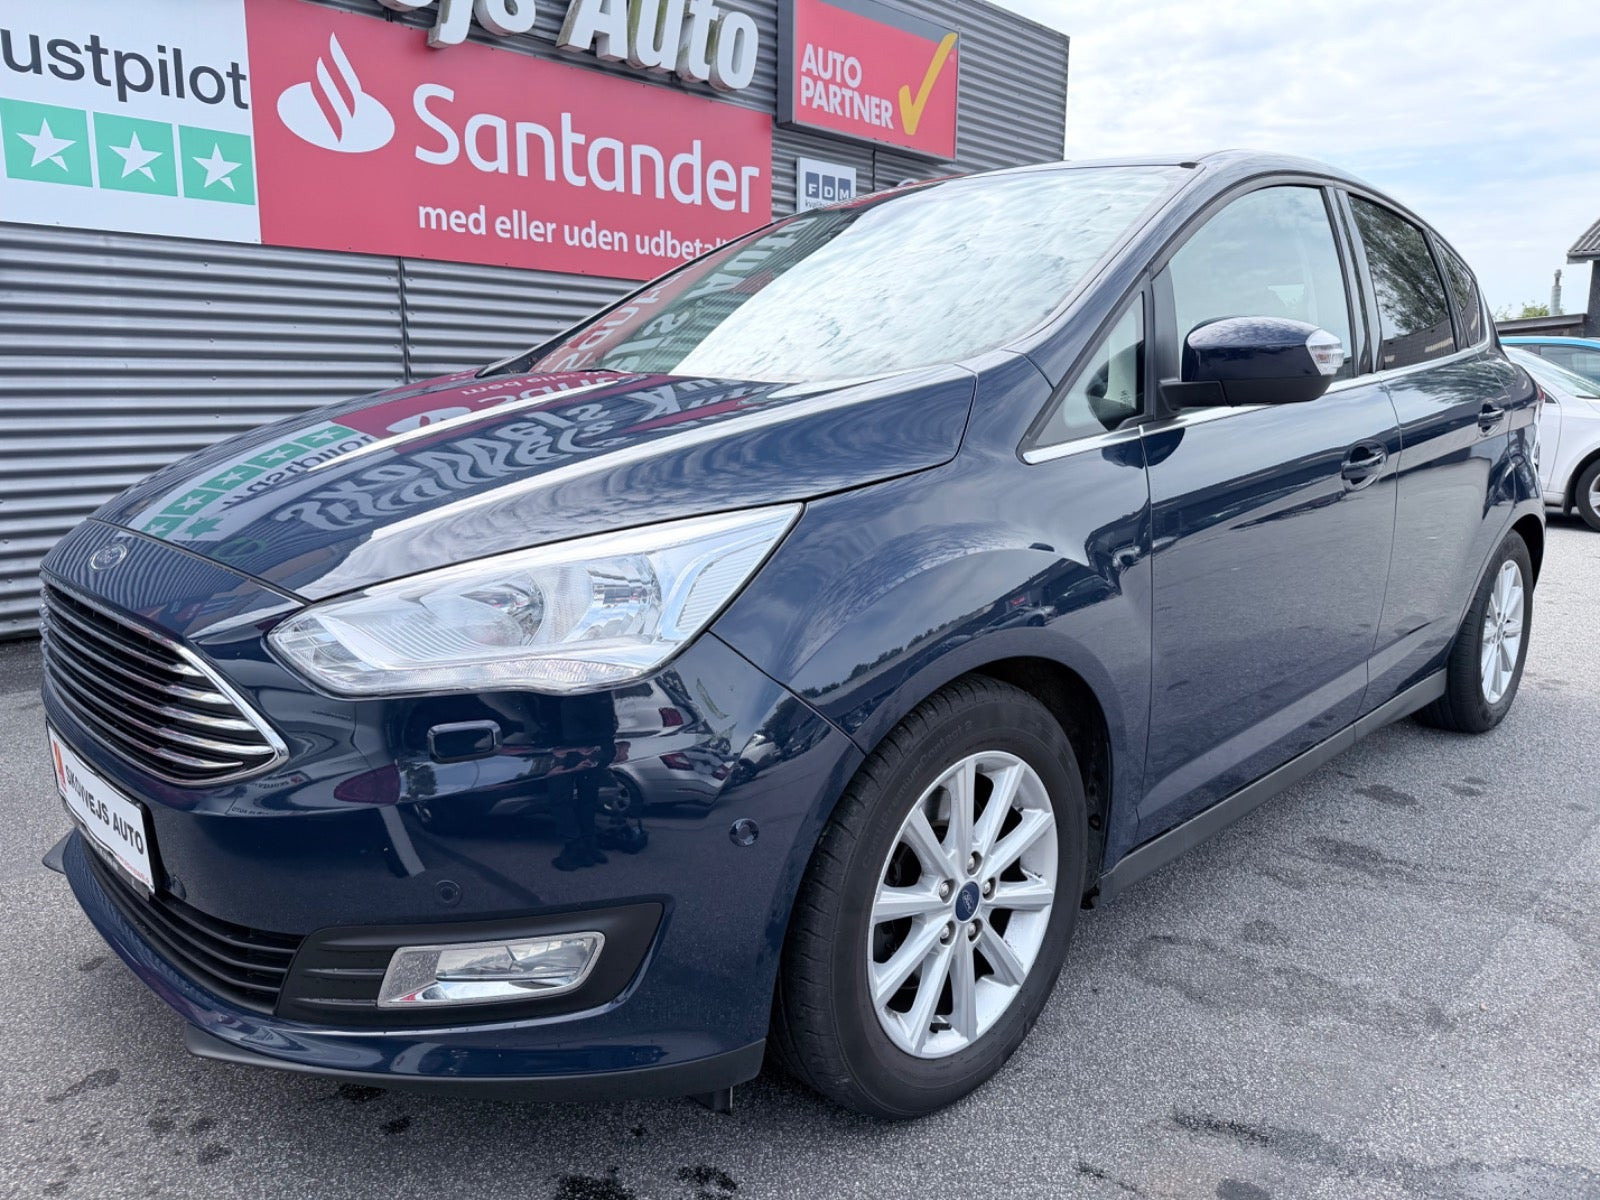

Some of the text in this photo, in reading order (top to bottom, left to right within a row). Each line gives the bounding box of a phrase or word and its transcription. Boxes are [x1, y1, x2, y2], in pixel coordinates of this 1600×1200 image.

[556, 0, 759, 91] Auto
[801, 43, 863, 88] AUTO
[801, 75, 894, 130] PARTNER
[412, 83, 760, 213] Santander
[418, 205, 487, 236] med
[495, 210, 557, 244] eller
[564, 220, 628, 253] uden
[113, 811, 144, 855] AUTO
